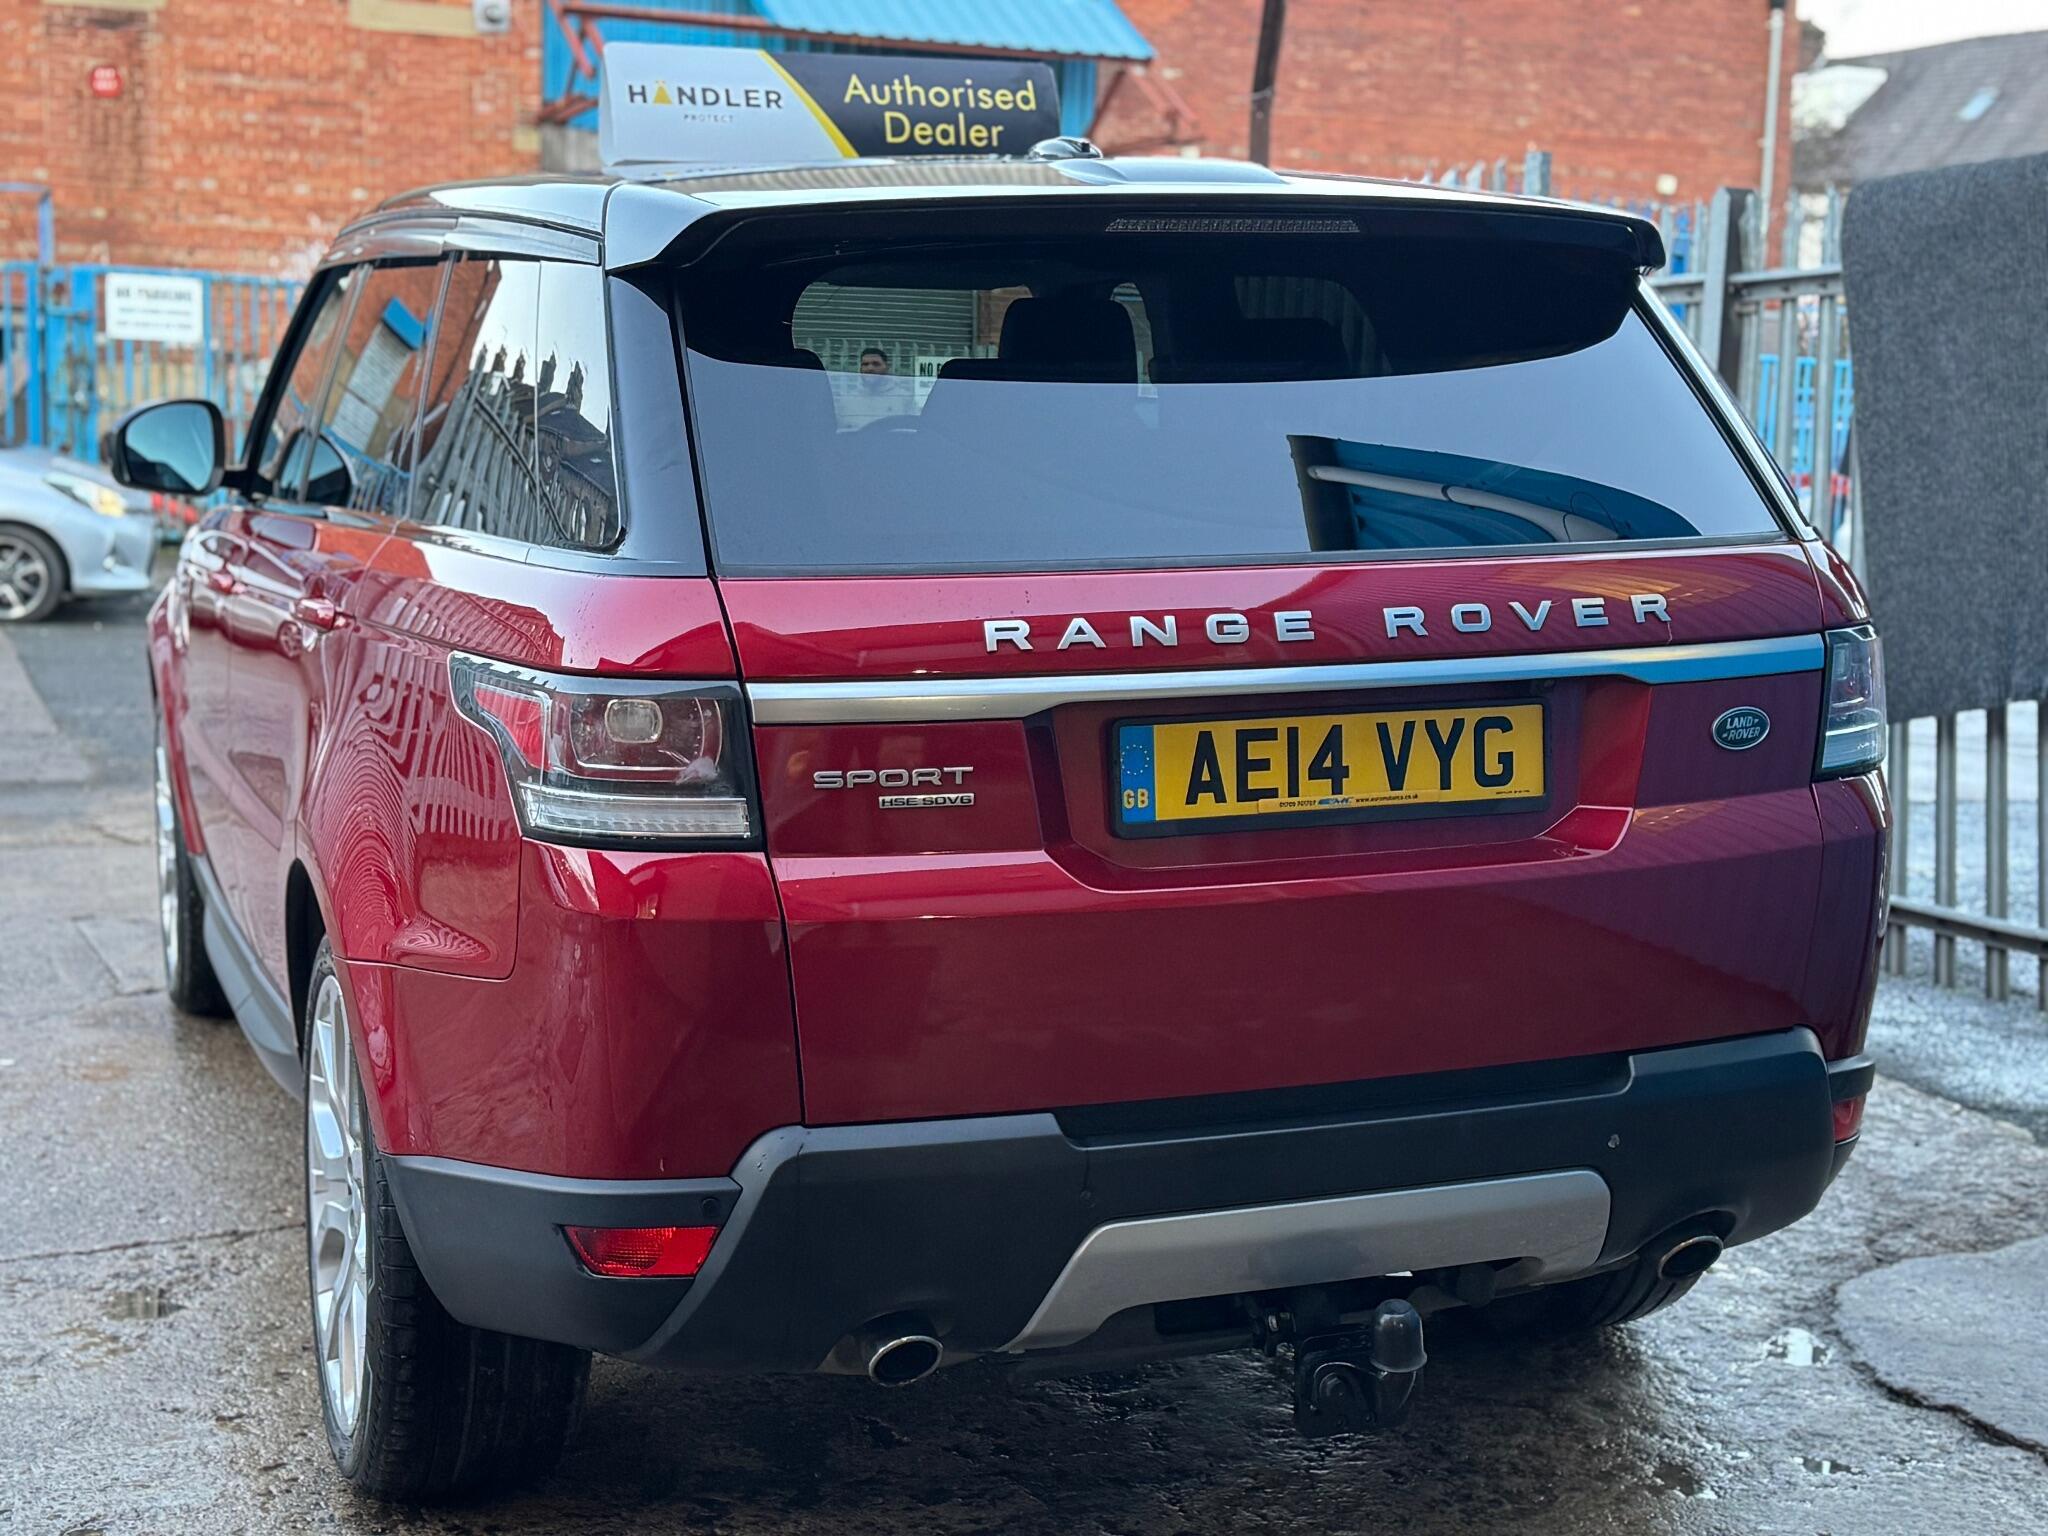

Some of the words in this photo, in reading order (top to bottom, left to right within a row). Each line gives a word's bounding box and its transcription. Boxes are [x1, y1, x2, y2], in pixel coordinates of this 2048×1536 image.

[844, 73, 1037, 111] Authorised
[683, 114, 735, 123] PROTECT
[884, 111, 1004, 147] Dealer
[984, 610, 1315, 652] RANGE
[1383, 593, 1672, 639] ROVER
[1726, 716, 1753, 730] LAND
[1727, 726, 1761, 741] ROVER
[1185, 724, 1350, 805] AE14
[1376, 716, 1514, 791] VYG
[813, 766, 974, 789] SPORT
[881, 797, 919, 807] HSE
[922, 795, 972, 806] SDV6
[1123, 788, 1149, 809] GB
